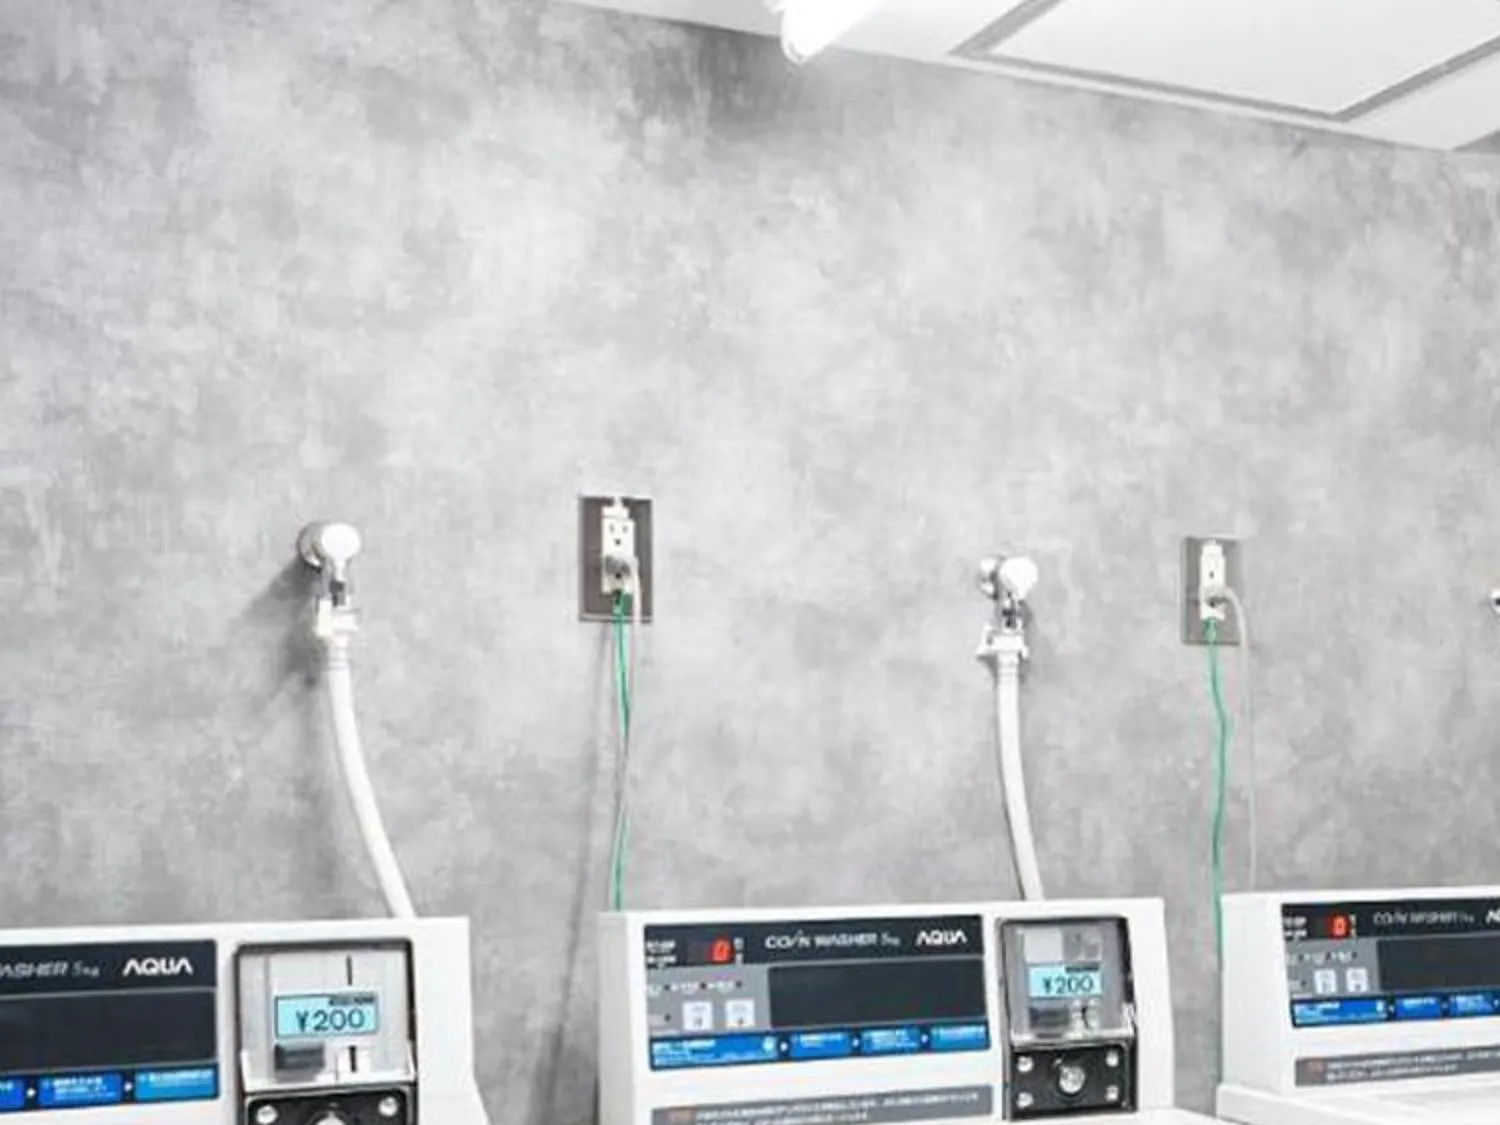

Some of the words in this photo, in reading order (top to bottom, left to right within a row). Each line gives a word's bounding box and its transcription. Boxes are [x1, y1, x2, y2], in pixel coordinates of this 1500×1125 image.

[915, 928, 969, 947] AQUA
[0, 961, 70, 979] ASHER
[122, 956, 194, 977] AQUA
[1041, 975, 1095, 994] ¥200
[295, 1007, 366, 1032] ¥200
